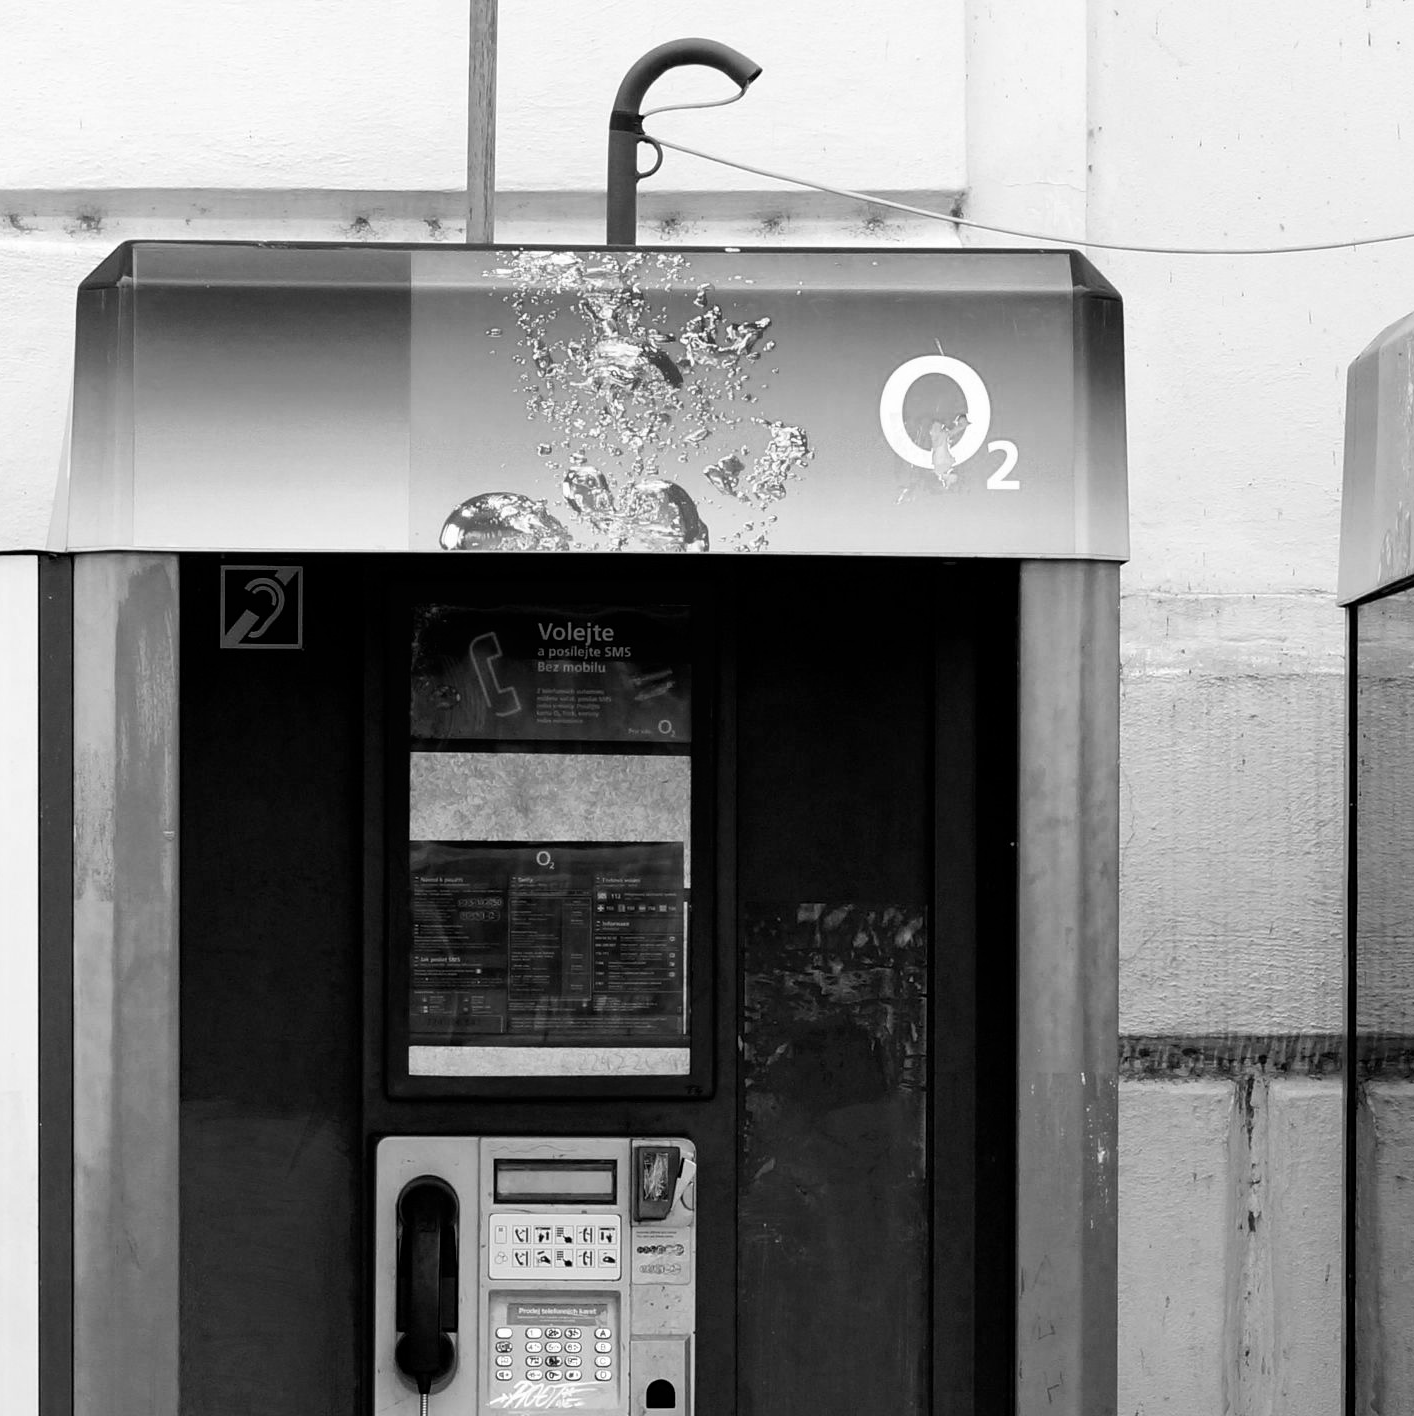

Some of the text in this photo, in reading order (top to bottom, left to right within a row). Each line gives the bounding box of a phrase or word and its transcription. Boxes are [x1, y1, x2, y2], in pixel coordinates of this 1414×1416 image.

[879, 354, 1020, 490] O2
[537, 621, 615, 646] Volejte
[537, 645, 632, 660] a posílejte SMS
[537, 661, 607, 673] Bez mobilu
[536, 850, 555, 870] O2
